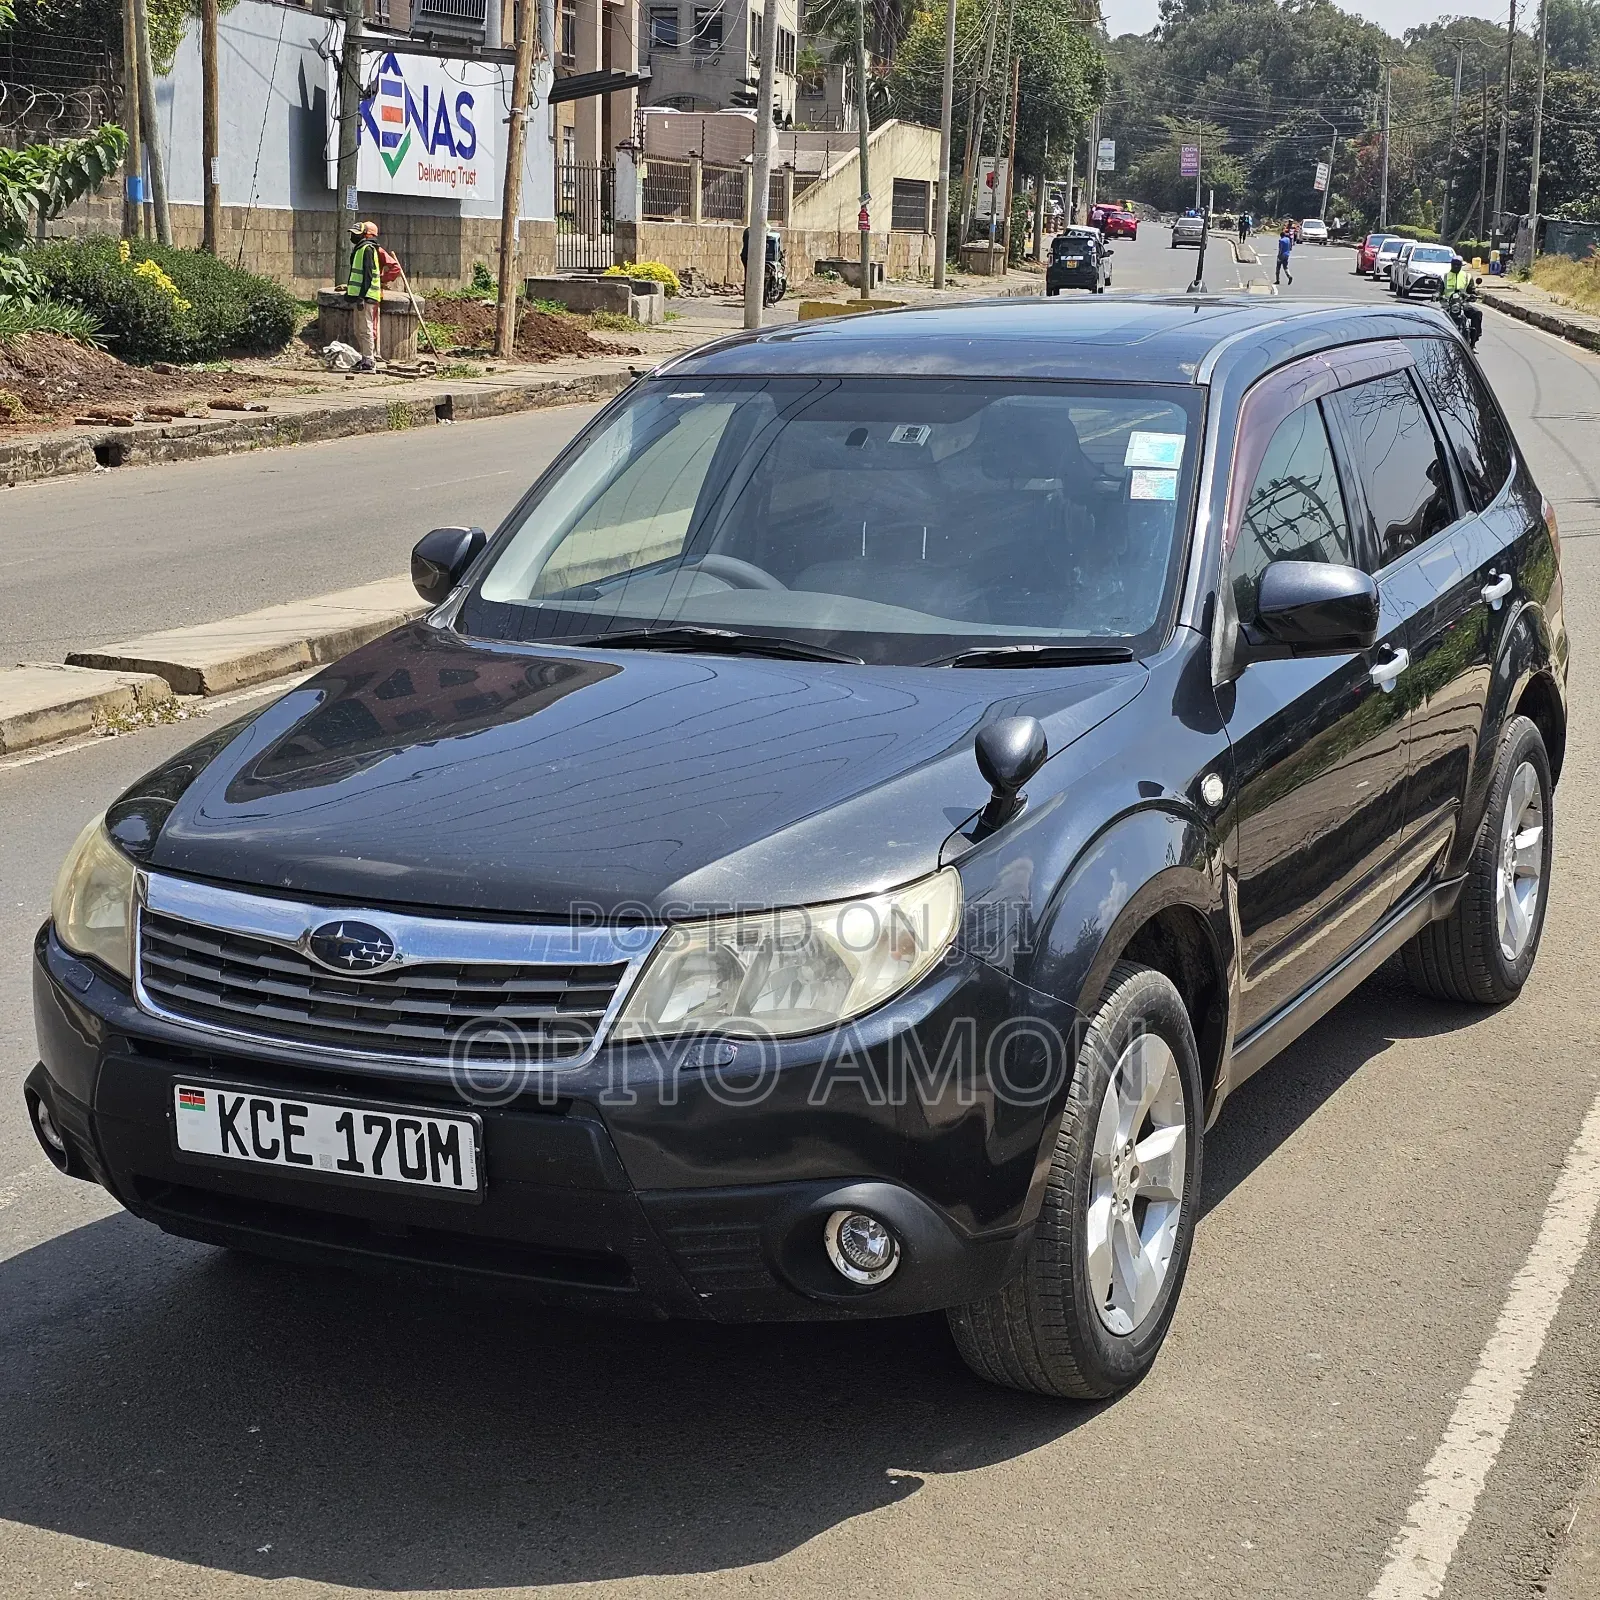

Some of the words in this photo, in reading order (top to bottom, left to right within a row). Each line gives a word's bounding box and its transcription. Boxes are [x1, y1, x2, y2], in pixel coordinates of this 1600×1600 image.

[418, 161, 457, 188] Delivering
[458, 166, 477, 186] Trust
[217, 1093, 313, 1166] KCE
[335, 1111, 463, 1186] 170M
